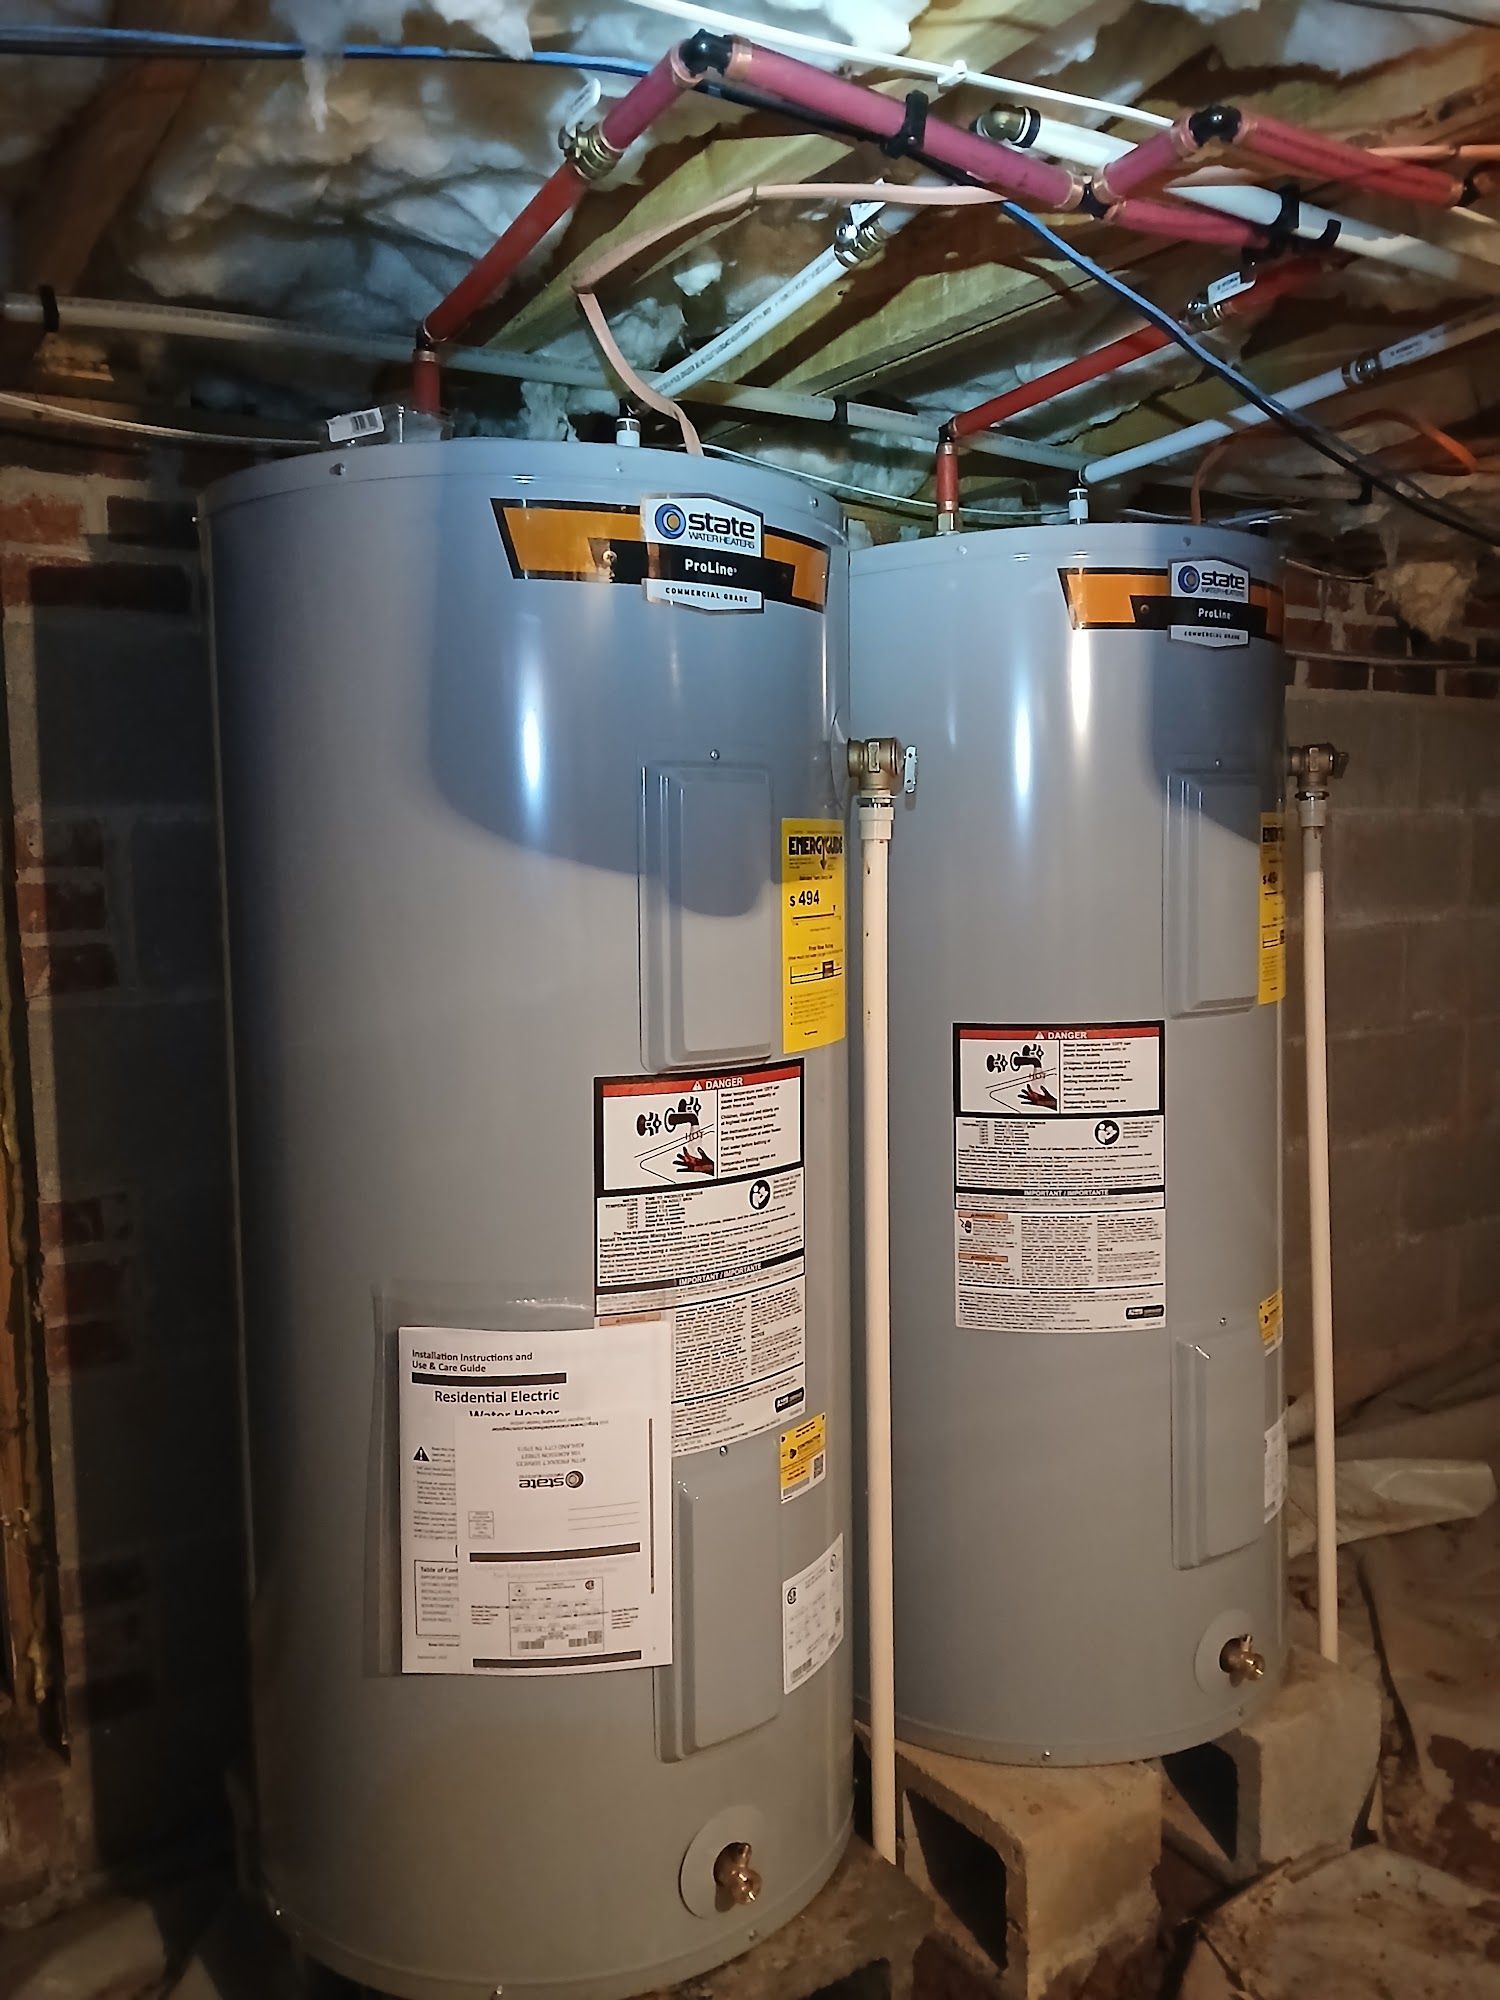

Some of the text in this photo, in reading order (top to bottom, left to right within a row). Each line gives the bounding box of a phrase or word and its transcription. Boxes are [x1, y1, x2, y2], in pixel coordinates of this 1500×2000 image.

[688, 512, 755, 540] state
[1201, 571, 1245, 590] state
[665, 587, 748, 603] COMMERCIAL GRADE
[1047, 1031, 1088, 1040] DANGER
[705, 1077, 743, 1090] DANGER
[678, 1272, 719, 1286] IMPORTANT
[723, 1262, 762, 1278] IMPORTANTE
[412, 1349, 533, 1362] Installation Instructions and
[412, 1360, 486, 1373] Use & Care Guide
[434, 1389, 560, 1403] Residential Electric
[519, 1477, 565, 1489] state
